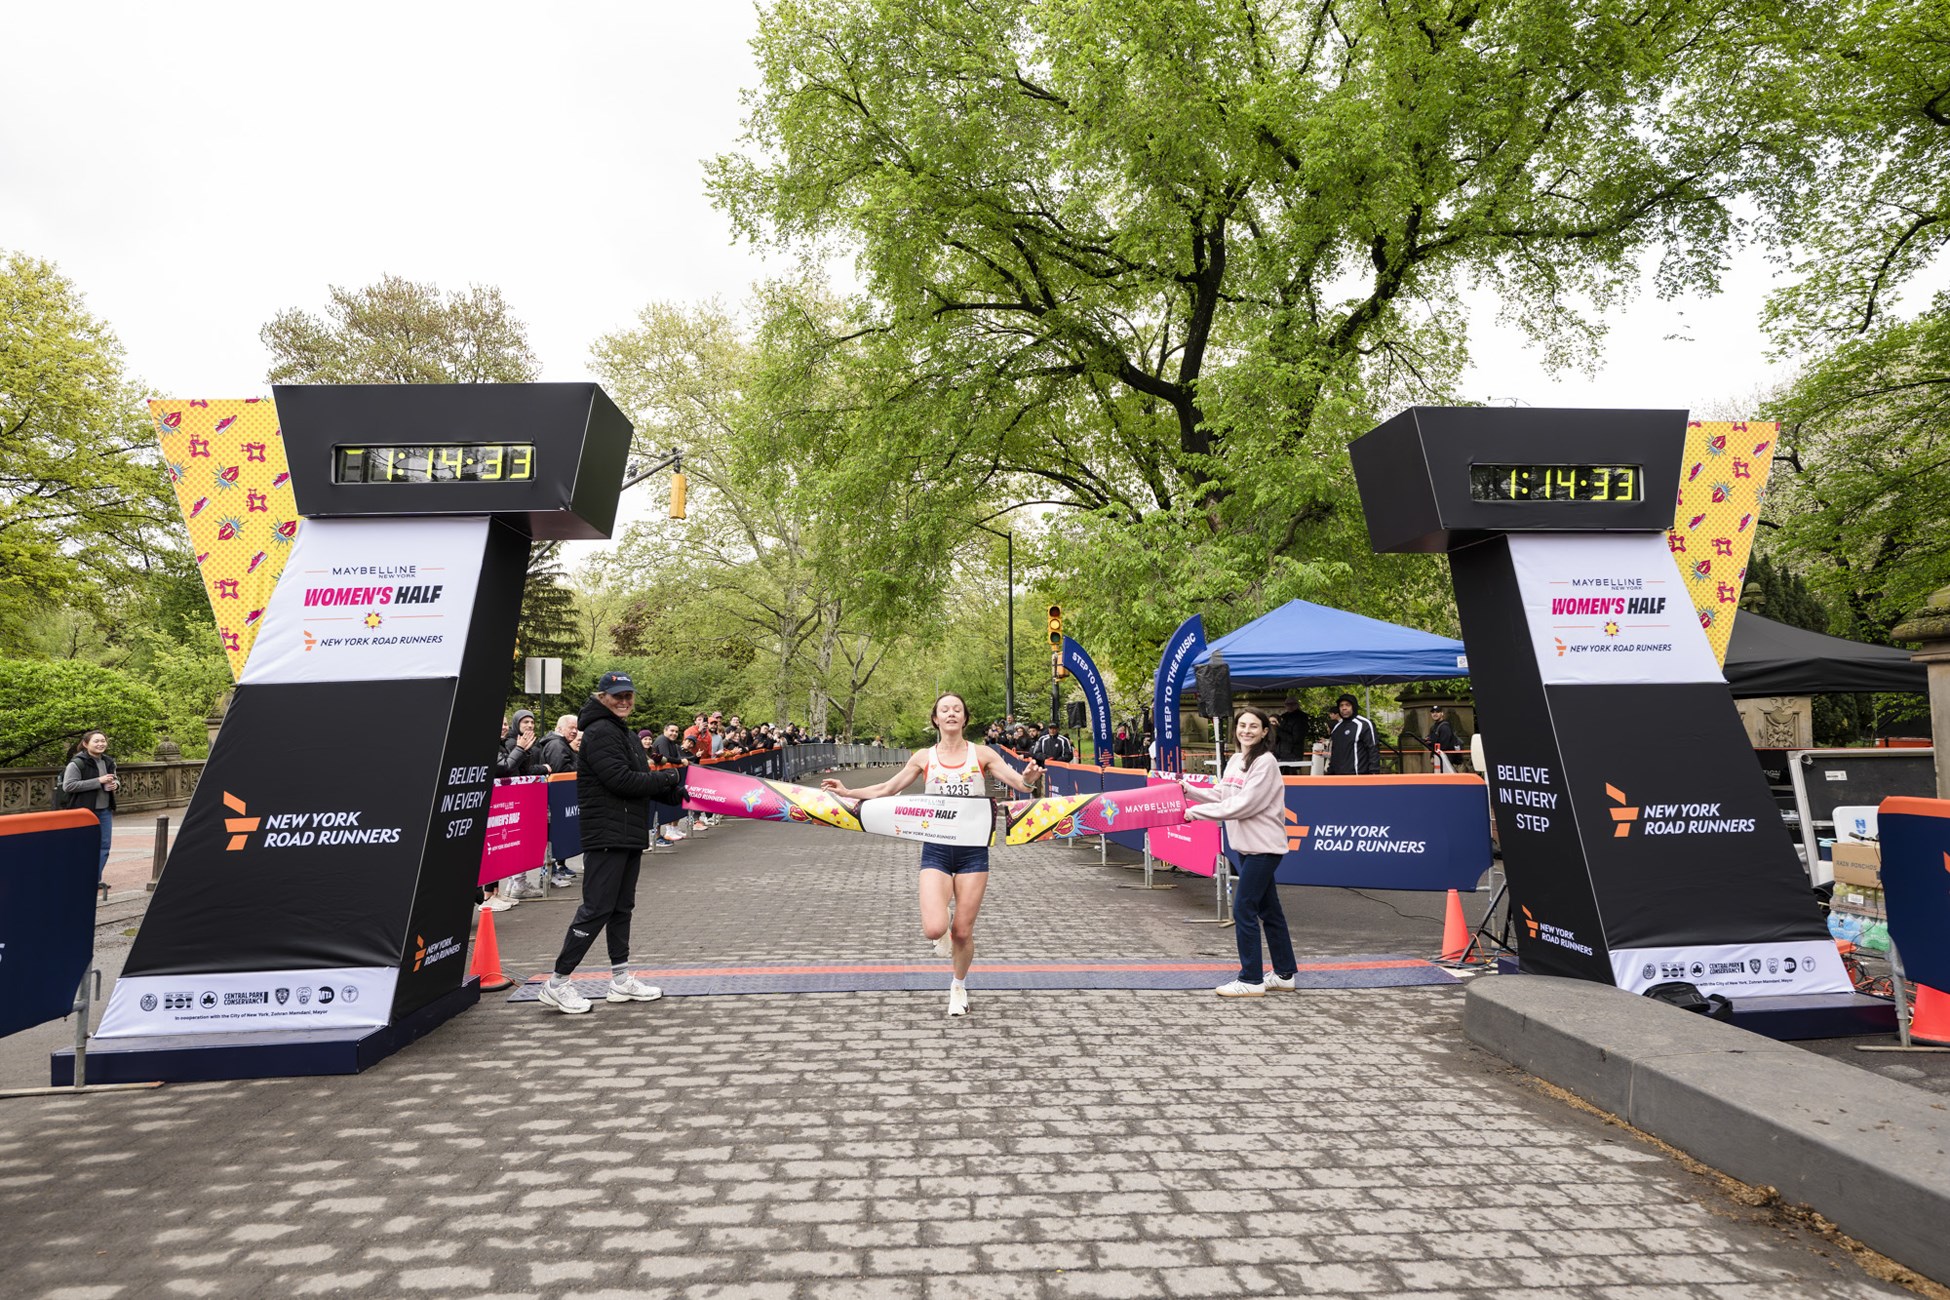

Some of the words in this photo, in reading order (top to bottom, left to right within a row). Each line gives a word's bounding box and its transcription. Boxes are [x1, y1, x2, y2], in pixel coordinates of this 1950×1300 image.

[332, 565, 417, 576] MAYBELLINE
[1572, 578, 1643, 586] MAYBELLINE
[303, 586, 394, 607] WOMEN'S
[394, 585, 443, 604] HALF
[1551, 597, 1626, 615] WOMEN'S
[1627, 597, 1666, 615] HALF
[320, 638, 344, 647] NEW
[344, 637, 370, 646] YORK
[371, 636, 398, 646] ROAD
[399, 635, 444, 645] RUNNERS
[1175, 632, 1197, 665] MUSIC
[1570, 645, 1589, 653] NEW
[1589, 645, 1611, 653] YORK
[1612, 644, 1635, 652] ROAD
[1636, 644, 1672, 652] RUNNERS
[1071, 651, 1089, 671] STEP
[1087, 668, 1096, 684] TO
[1168, 663, 1180, 685] THE
[1093, 683, 1105, 705] THE
[1164, 685, 1173, 707] TO
[1098, 704, 1107, 740] MUSIC
[1164, 707, 1173, 740] STEP
[447, 765, 489, 786] BELIEVE
[1497, 764, 1550, 785] BELIEVE
[701, 793, 727, 803] RUNNERS
[702, 787, 717, 795] YORK
[945, 784, 970, 796] 3235
[1499, 787, 1513, 804] IN
[1514, 789, 1558, 810] EVERY
[440, 794, 455, 813] IN
[453, 790, 487, 811] EVERY
[1125, 800, 1181, 814] MAYBELLINE
[894, 805, 935, 818] WOMEN'S
[934, 809, 958, 820] HALF
[1643, 804, 1680, 819] NEW
[1680, 803, 1722, 817] YORK
[265, 813, 310, 830] NEW
[311, 811, 362, 828] YORK
[445, 818, 473, 839] STEP
[1516, 813, 1550, 833] STEP
[1644, 821, 1685, 835] ROAD
[1687, 819, 1755, 834] RUNNERS
[263, 832, 315, 848] ROAD
[317, 828, 402, 846] RUNNERS
[1313, 824, 1349, 837] NEW
[1349, 825, 1391, 838] YORK
[1313, 839, 1354, 852] ROAD
[1355, 839, 1426, 853] RUNNERS
[1850, 862, 1877, 871] PONCHOS
[1540, 923, 1555, 934] NEW
[1555, 928, 1575, 940] YORK
[1541, 932, 1560, 945] ROAD
[1560, 939, 1593, 956] RUNNERS
[1709, 967, 1740, 975] CONSERVANCY
